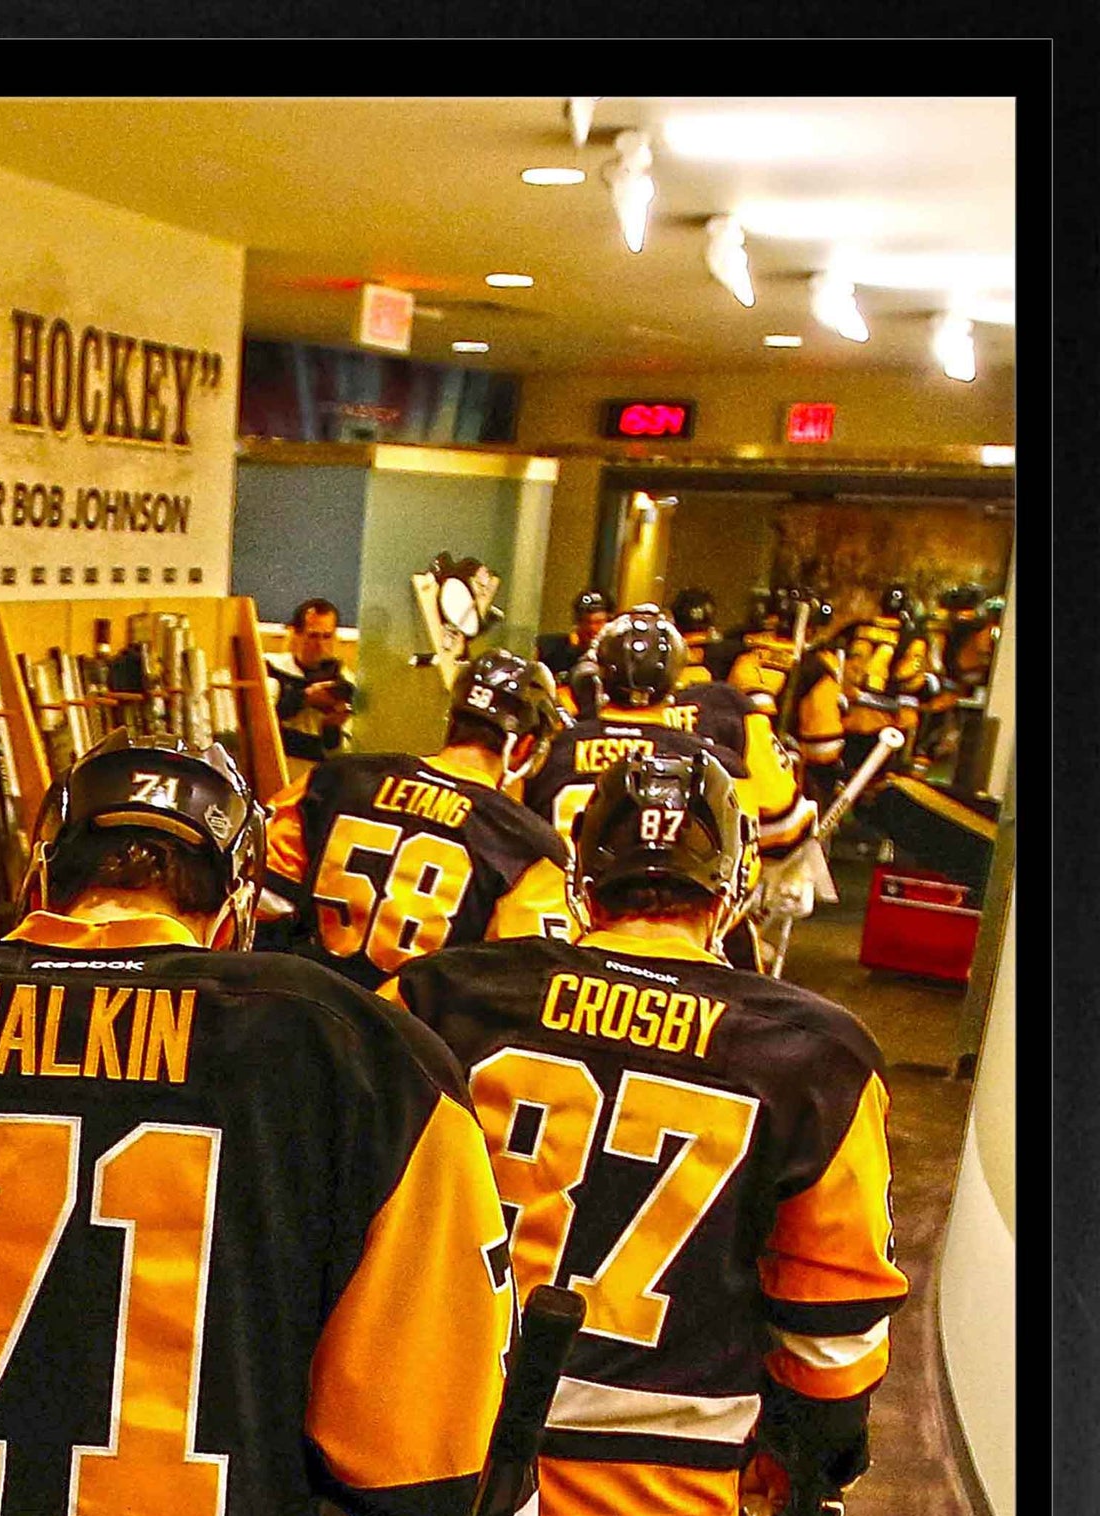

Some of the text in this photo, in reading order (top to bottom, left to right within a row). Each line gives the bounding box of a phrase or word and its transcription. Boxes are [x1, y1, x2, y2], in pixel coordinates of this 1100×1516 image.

[11, 482, 64, 527] BOB
[68, 489, 191, 534] JOHNSON
[128, 771, 180, 811] 71
[373, 775, 473, 829] LETANG
[640, 809, 684, 843] 87
[312, 813, 474, 974] 58
[541, 972, 729, 1059] CROSBY
[468, 1046, 761, 1349] 87
